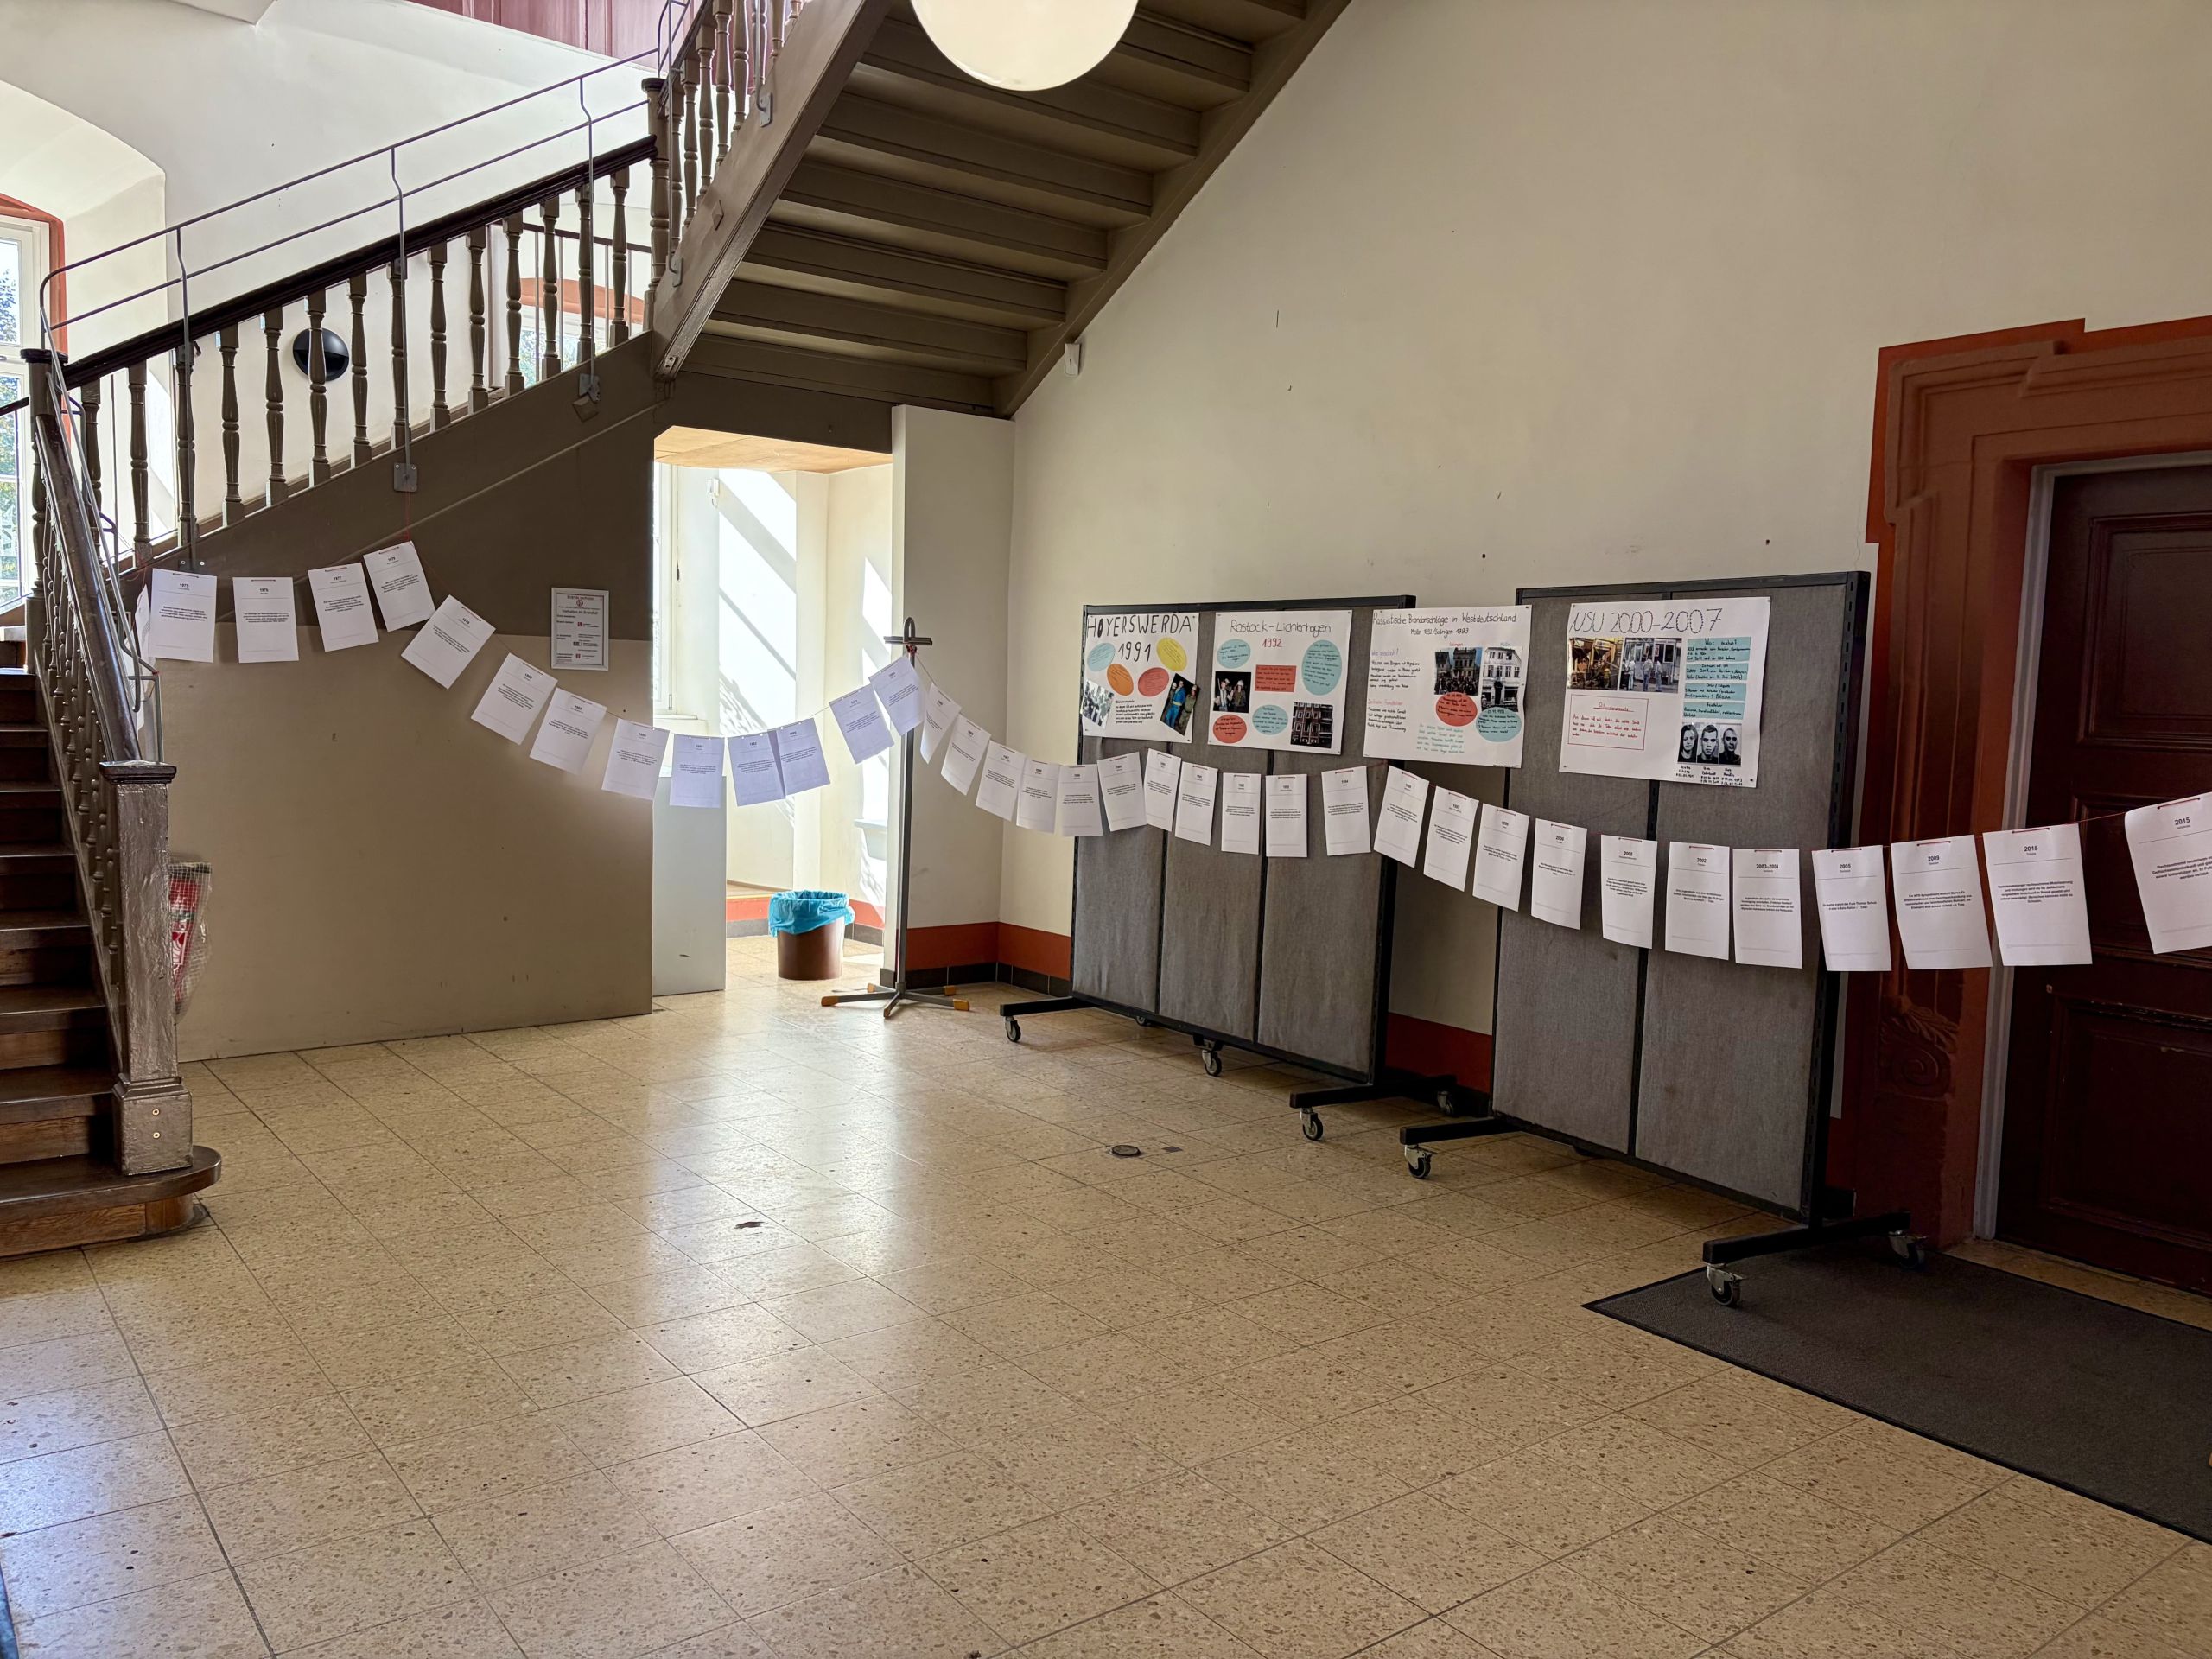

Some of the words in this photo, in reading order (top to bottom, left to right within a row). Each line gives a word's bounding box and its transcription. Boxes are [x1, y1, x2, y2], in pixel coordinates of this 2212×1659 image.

[1087, 613, 1192, 638] HOYERSWERDA
[1569, 611, 1605, 633] NSU
[1118, 641, 1152, 662] 1991
[1262, 638, 1283, 648] 1992
[2174, 817, 2190, 826] 2015
